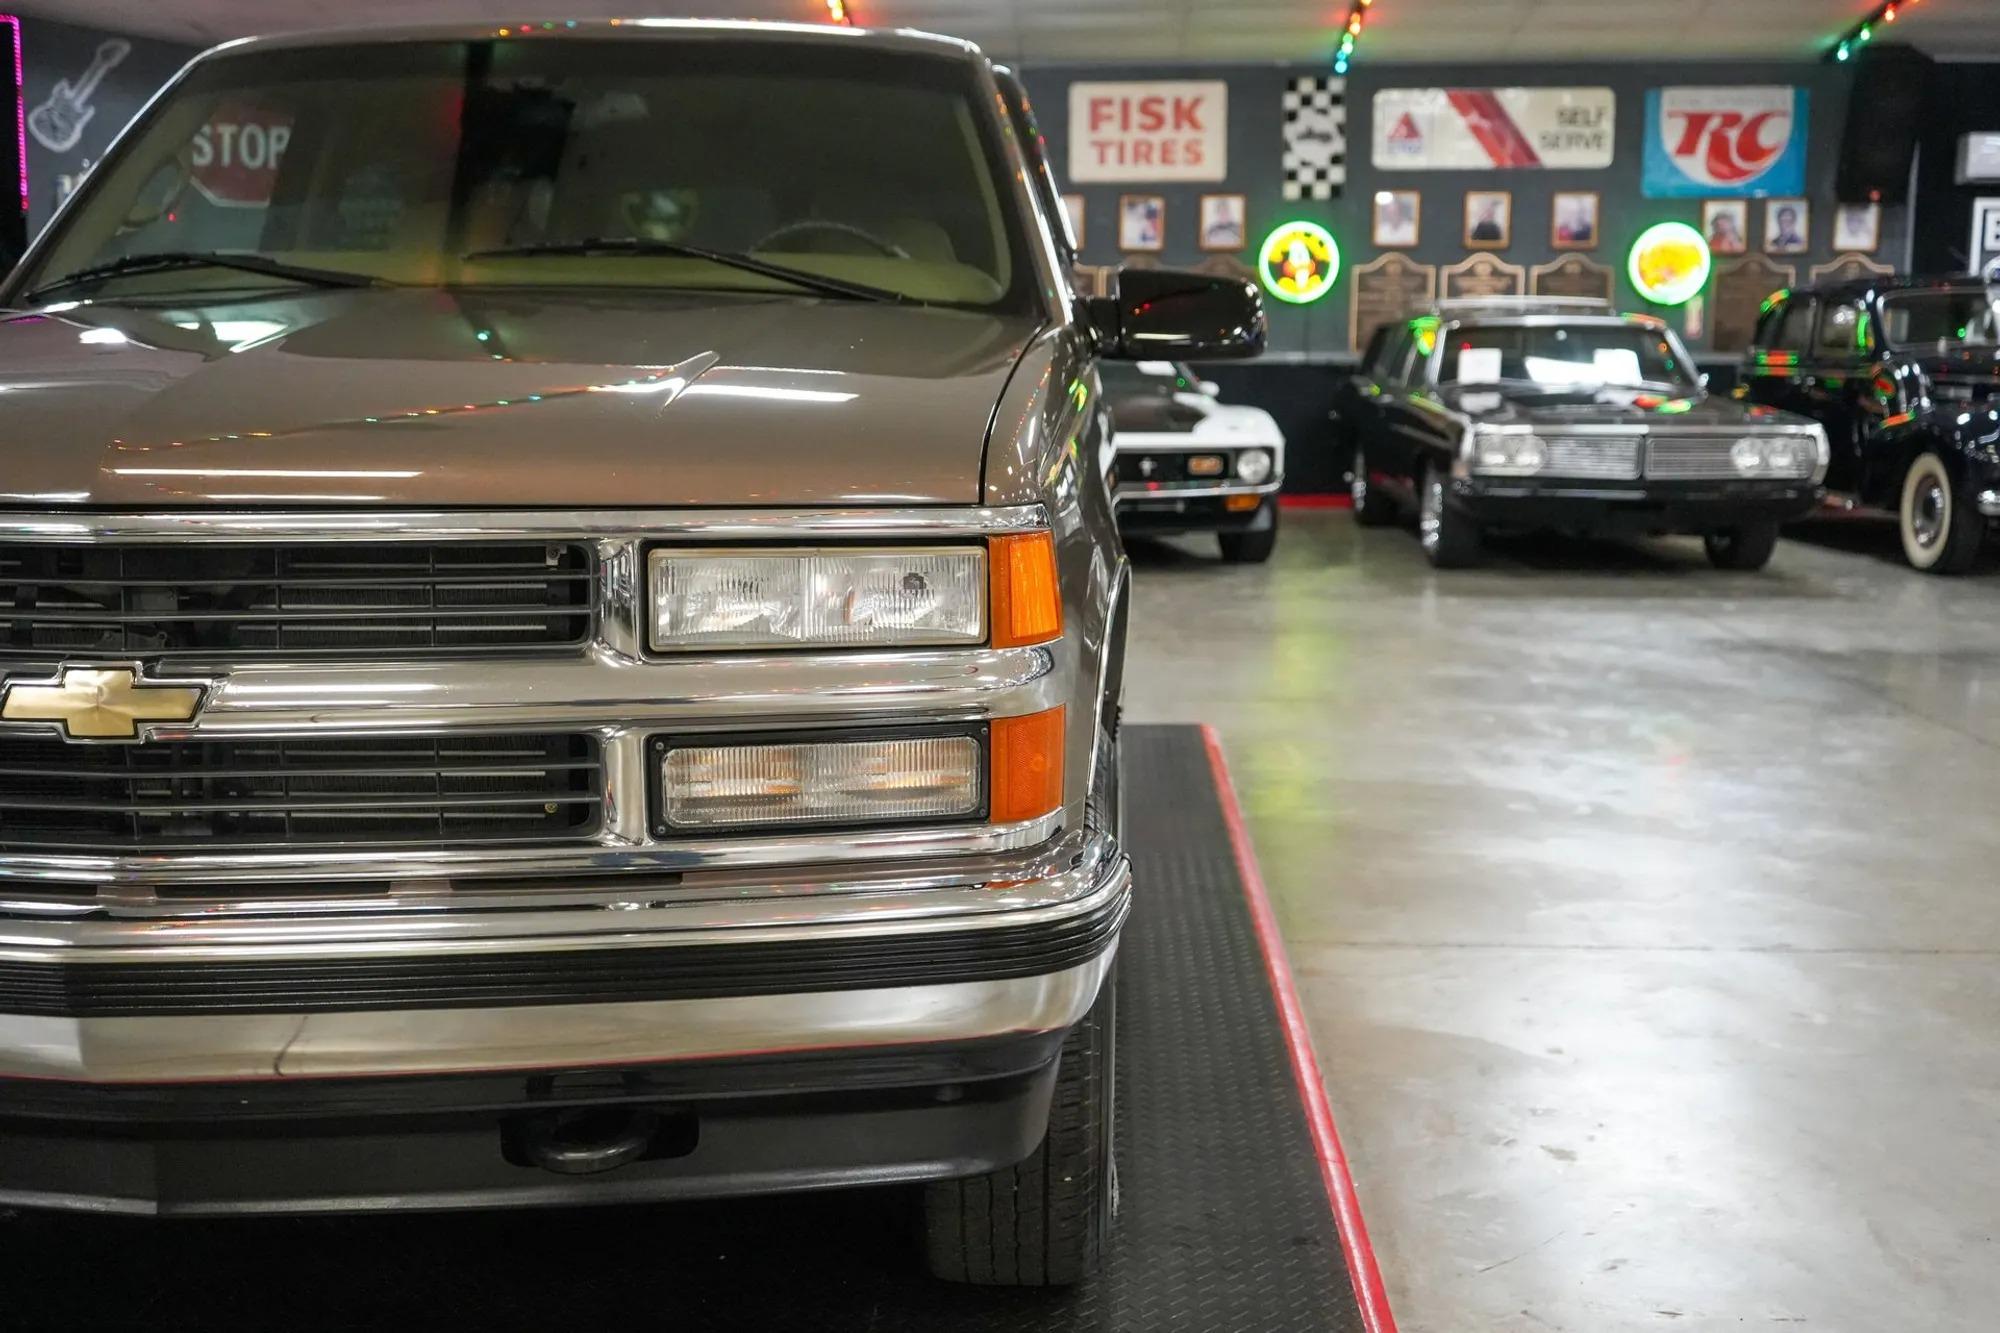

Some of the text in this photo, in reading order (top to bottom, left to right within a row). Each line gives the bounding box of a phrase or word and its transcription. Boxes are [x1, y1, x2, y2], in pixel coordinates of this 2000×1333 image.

[1090, 97, 1205, 131] FISK
[1556, 108, 1606, 126] SELF
[192, 123, 291, 169] STOP
[1090, 139, 1205, 165] TIRES
[1540, 131, 1608, 149] SERVE
[1667, 110, 1788, 180] RC
